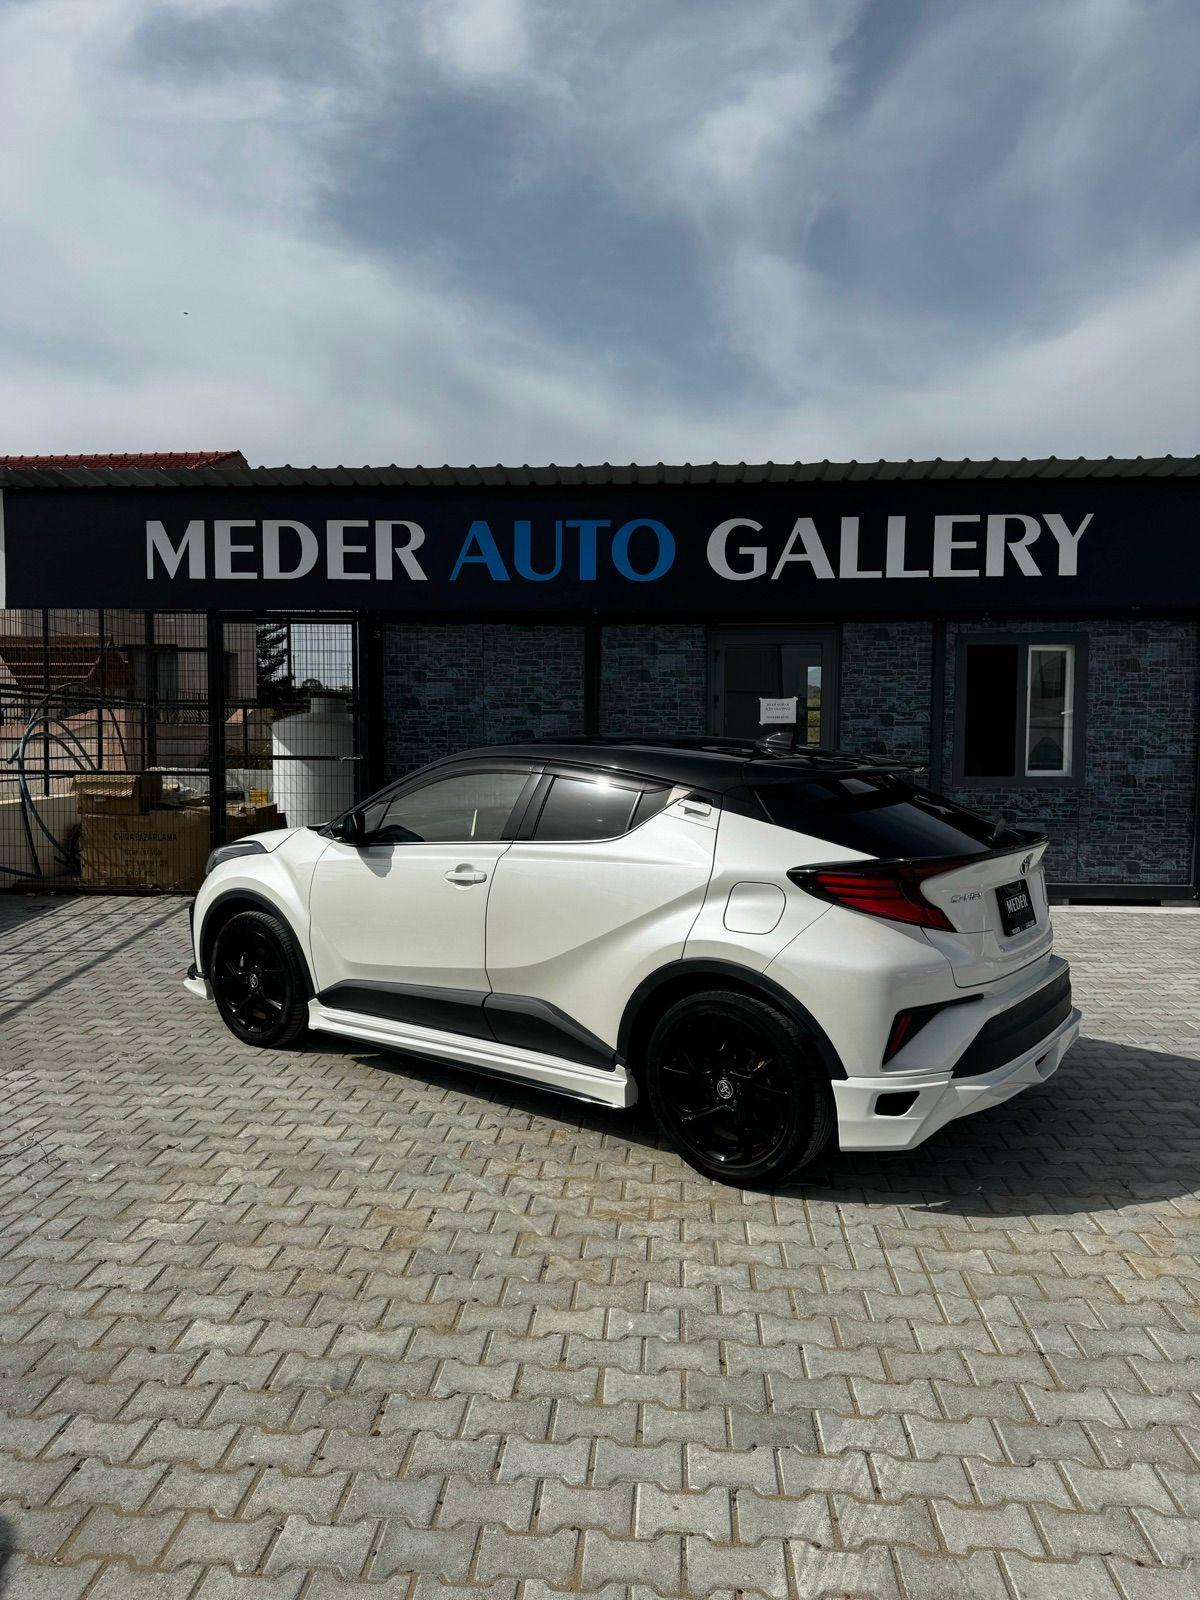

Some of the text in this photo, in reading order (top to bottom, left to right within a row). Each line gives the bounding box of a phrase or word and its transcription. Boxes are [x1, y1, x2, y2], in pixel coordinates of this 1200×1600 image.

[146, 513, 1094, 583] MEDER AUTO GALLERY
[1006, 894, 1029, 914] MEDER
